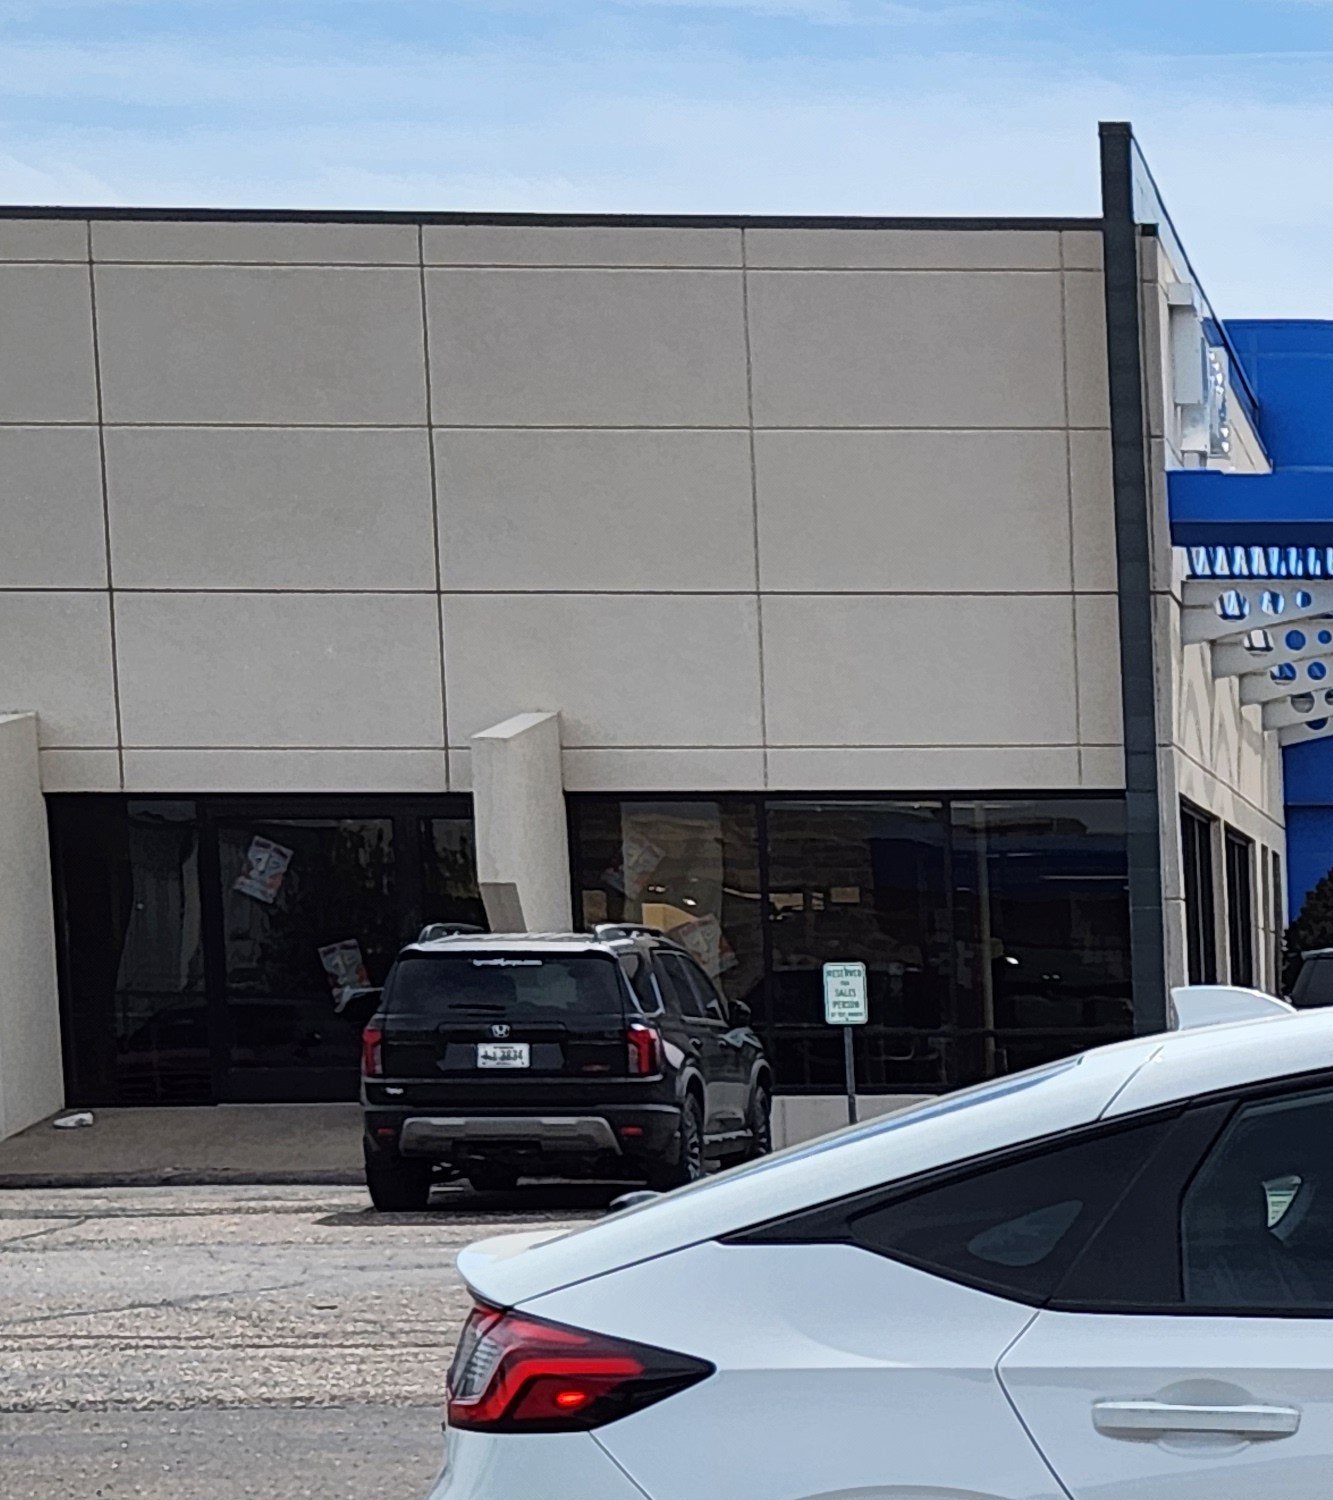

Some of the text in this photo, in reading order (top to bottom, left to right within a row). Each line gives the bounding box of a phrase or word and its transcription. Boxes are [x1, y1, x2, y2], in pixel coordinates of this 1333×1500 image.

[826, 969, 862, 977] RESERVED
[835, 989, 856, 997] SALES
[832, 1000, 860, 1009] PERSON
